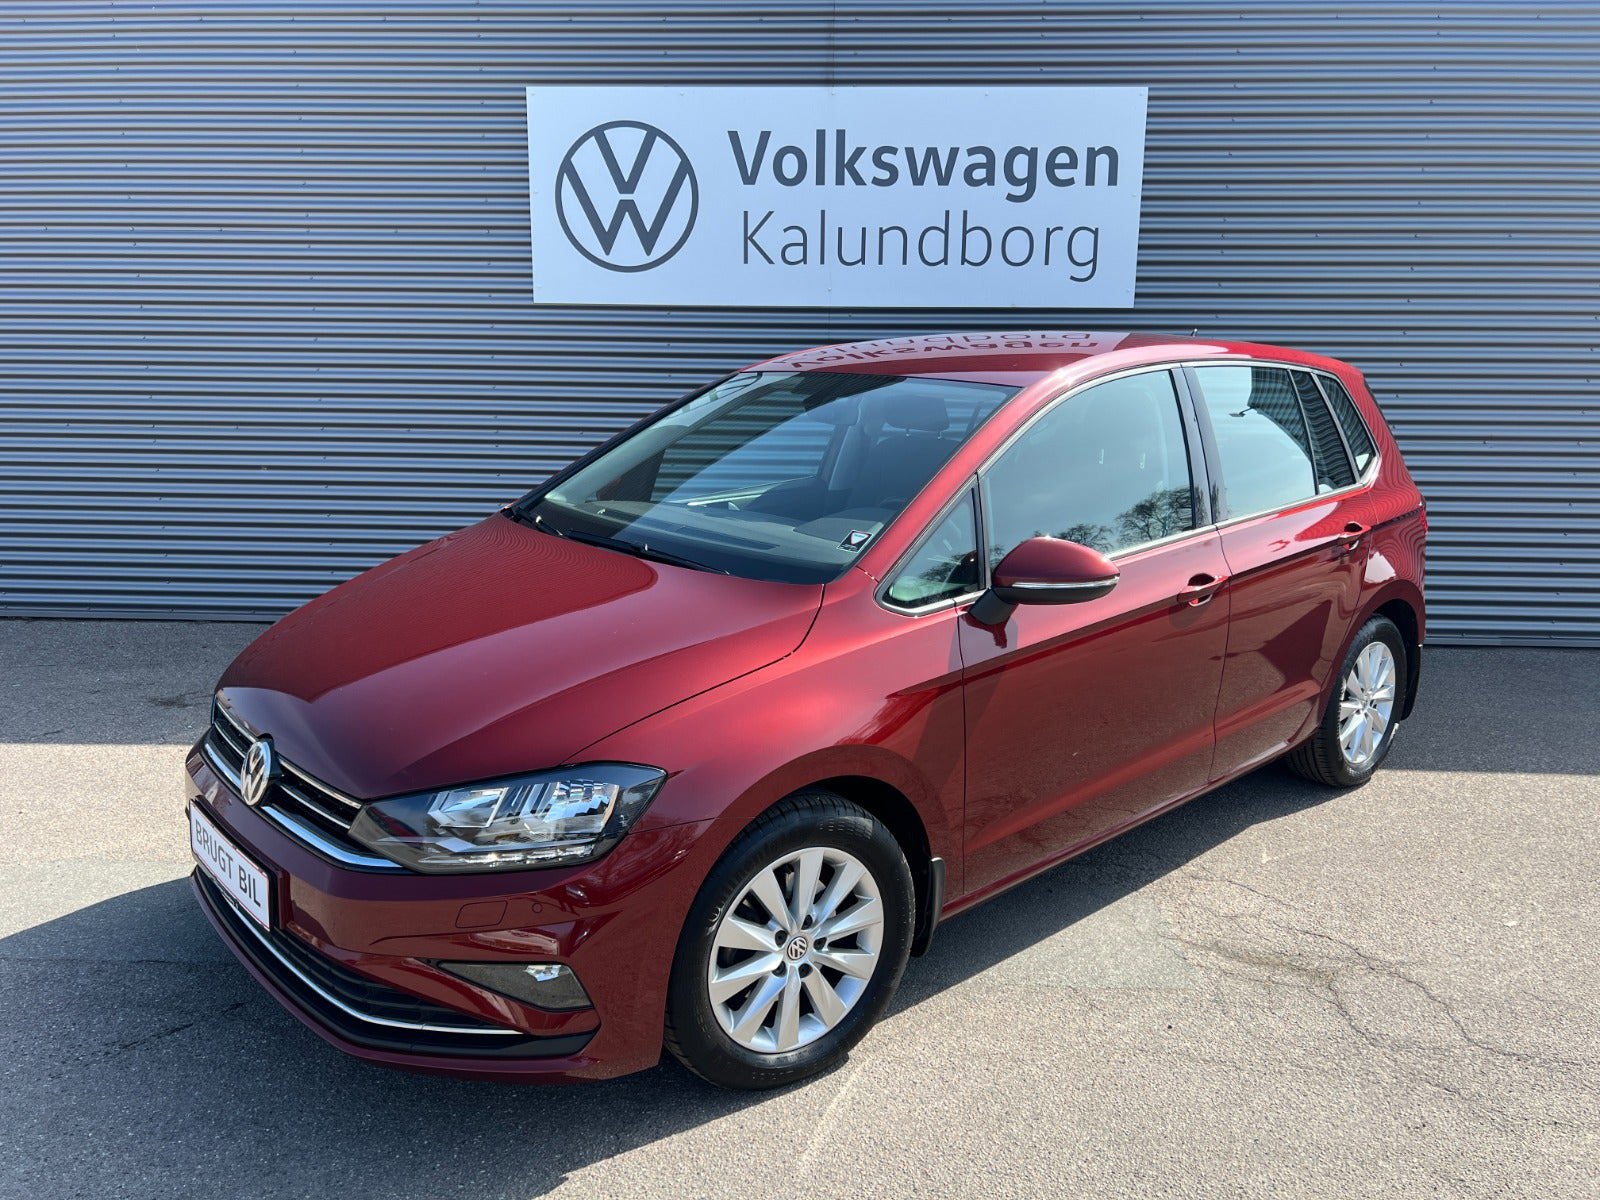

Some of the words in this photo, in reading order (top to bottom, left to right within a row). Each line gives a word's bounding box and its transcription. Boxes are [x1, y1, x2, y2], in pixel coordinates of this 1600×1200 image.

[727, 129, 1119, 203] Volkswagen
[742, 210, 1100, 283] Kalundborg
[195, 820, 233, 879] BRUGT
[238, 865, 262, 908] BIL
